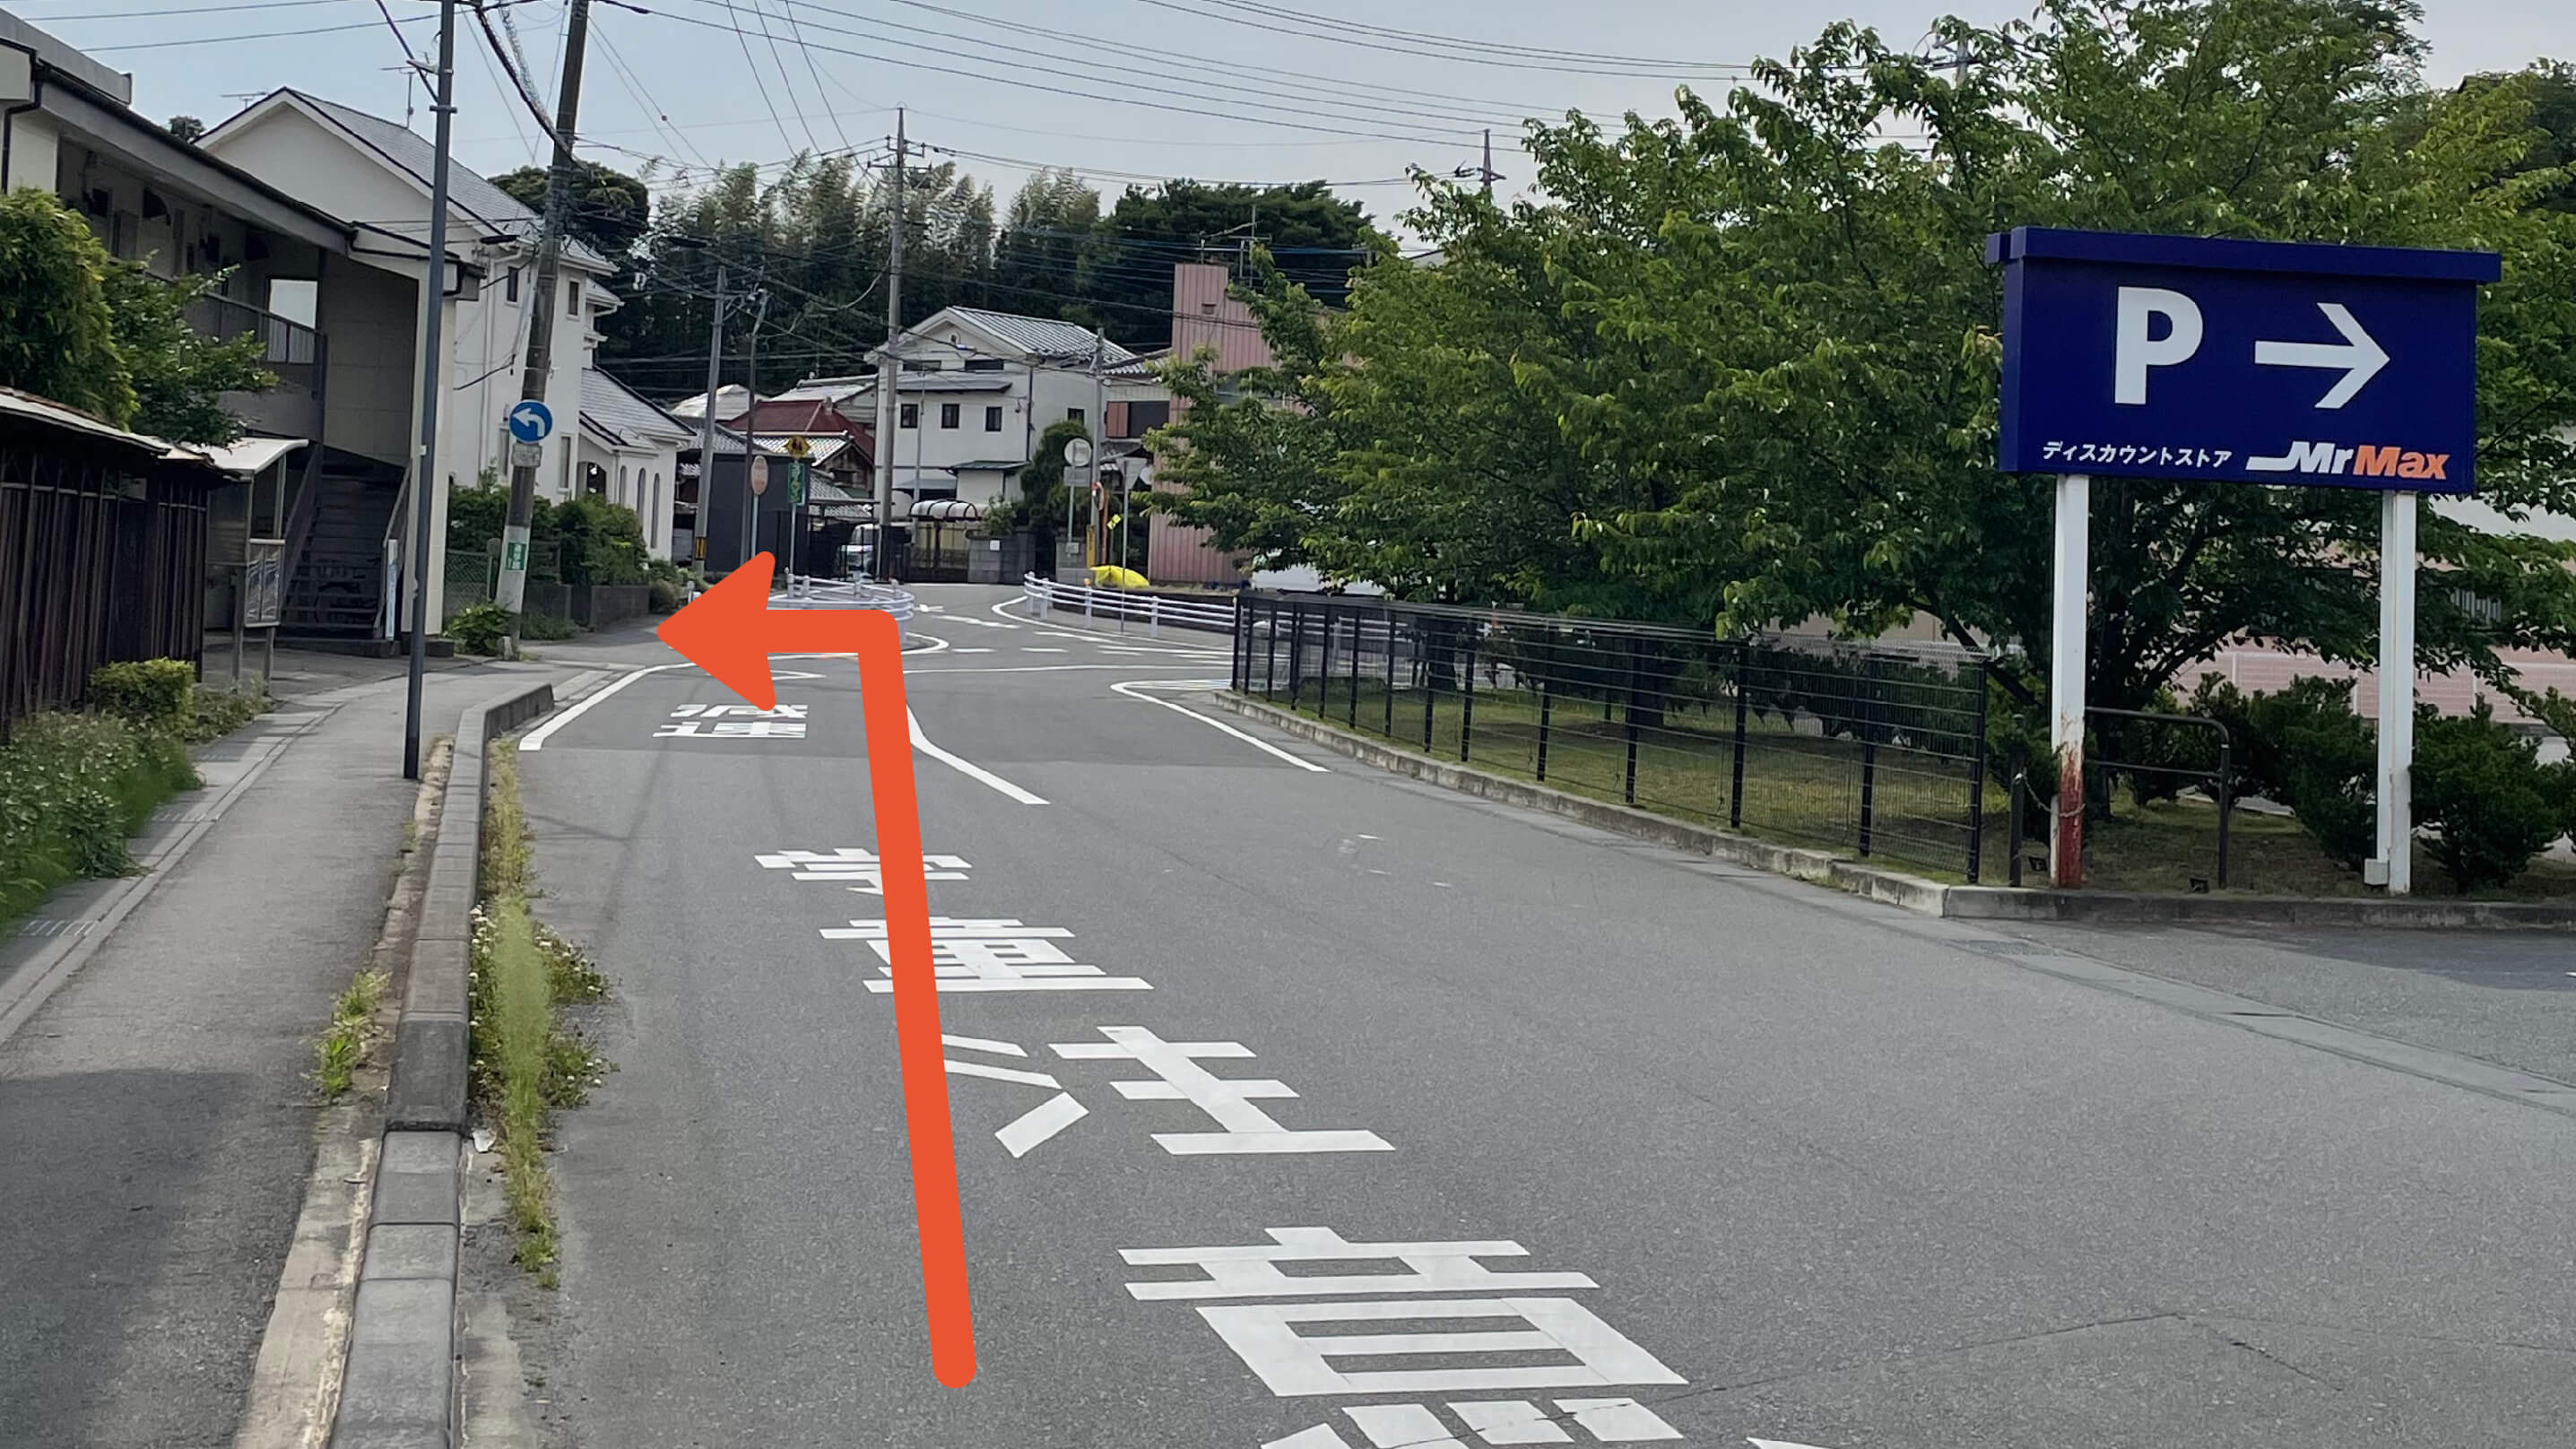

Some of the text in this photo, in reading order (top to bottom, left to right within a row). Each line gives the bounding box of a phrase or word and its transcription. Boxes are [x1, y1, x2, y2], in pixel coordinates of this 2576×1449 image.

[2114, 286, 2203, 405] P
[2043, 441, 2233, 468] ディスカウントストア
[2245, 440, 2450, 481] MrMax
